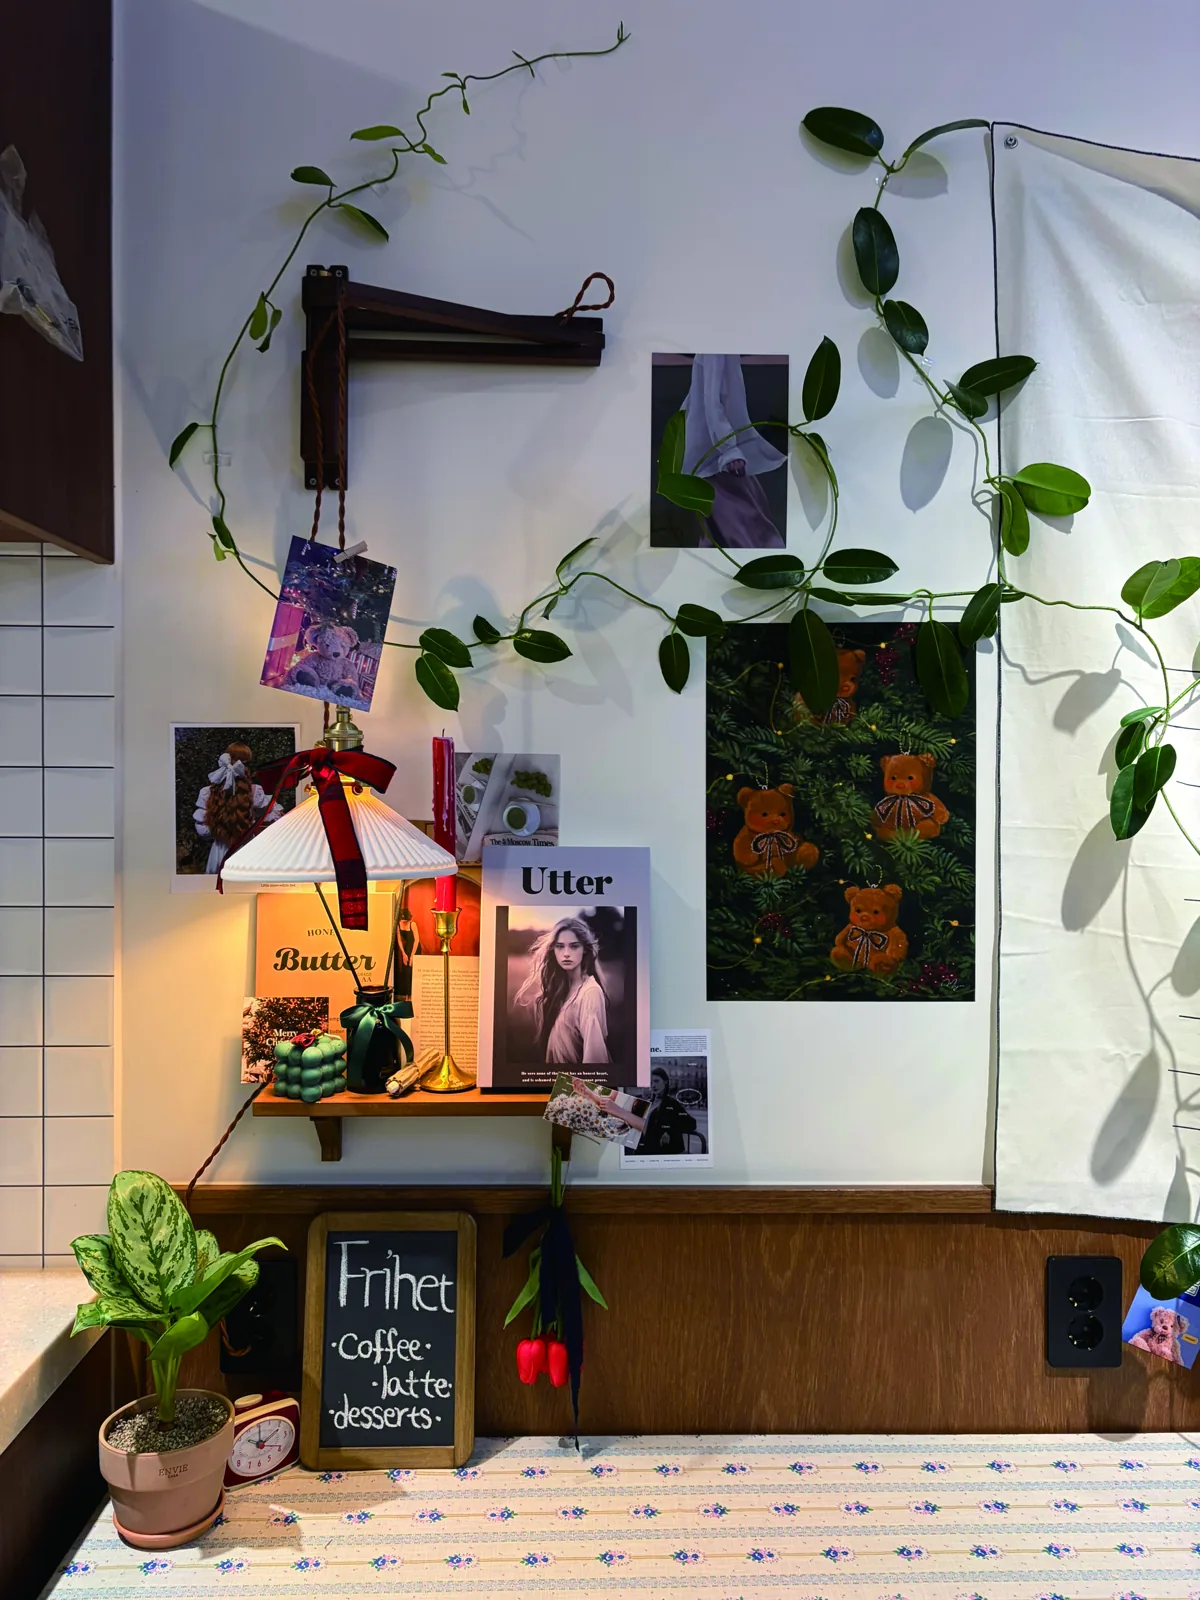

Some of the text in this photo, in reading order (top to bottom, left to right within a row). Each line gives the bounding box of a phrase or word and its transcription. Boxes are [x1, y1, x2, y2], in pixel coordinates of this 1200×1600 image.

[490, 837, 555, 847] The Moscow Times
[521, 866, 613, 895] Utter
[307, 928, 342, 937] HONE
[273, 947, 376, 971] Butter
[273, 1028, 299, 1037] Merry
[381, 1365, 451, 1399] latte
[333, 1393, 433, 1430] desserts
[159, 1464, 189, 1476] ENVIE
